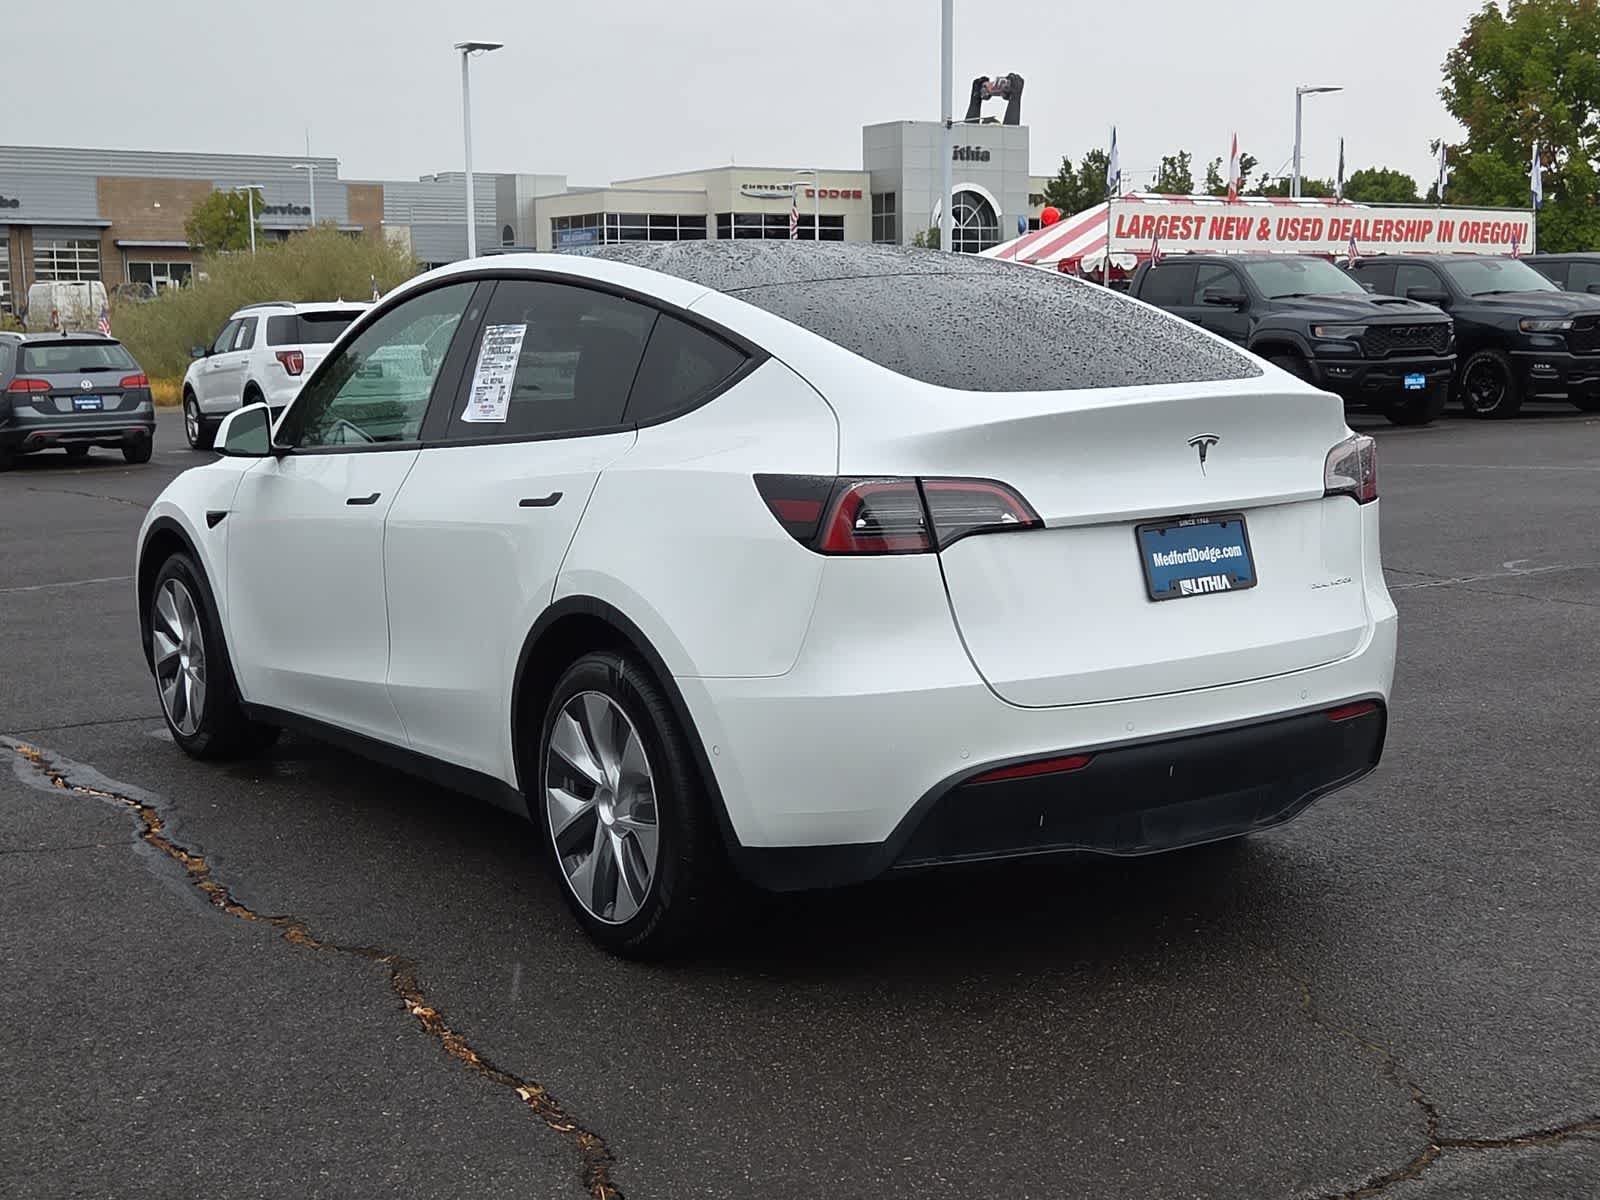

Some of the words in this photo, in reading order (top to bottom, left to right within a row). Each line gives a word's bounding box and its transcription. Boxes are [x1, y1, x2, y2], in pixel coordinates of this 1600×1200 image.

[952, 145, 990, 162] ithia
[804, 188, 863, 199] DODGE
[263, 203, 311, 215] ervice
[1115, 214, 1205, 240] LARGEST
[1208, 215, 1254, 241] NEW
[1256, 217, 1271, 241] &
[1276, 217, 1324, 242] USED
[1327, 218, 1433, 242] DEALERSHIP
[1437, 220, 1455, 243] IN
[1458, 220, 1529, 244] OREGON!
[1153, 545, 1243, 568] MedfordDodge.com
[1193, 574, 1232, 594] LITHIA
